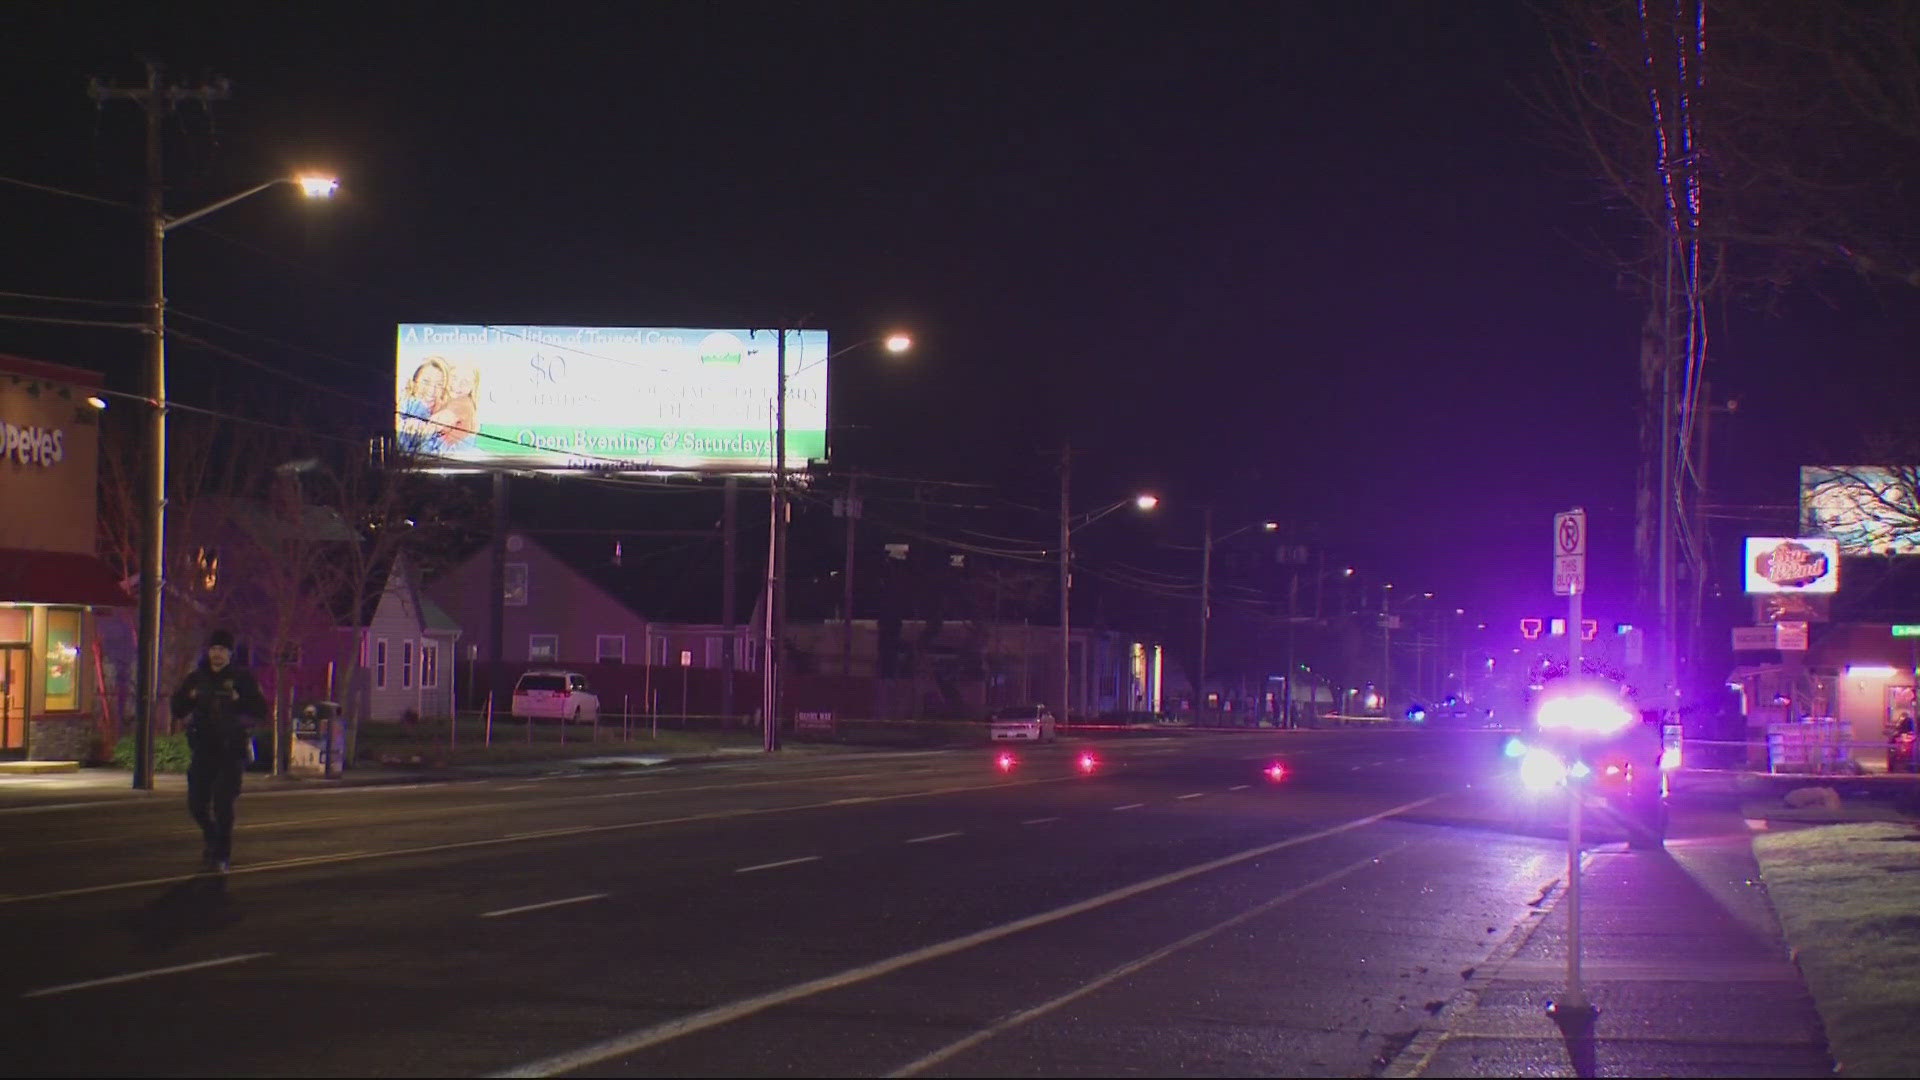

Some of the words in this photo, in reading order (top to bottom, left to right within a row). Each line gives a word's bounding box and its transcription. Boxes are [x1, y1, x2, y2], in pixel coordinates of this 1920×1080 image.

[406, 328, 418, 343] A
[424, 327, 488, 344] Portland
[567, 329, 583, 345] of
[647, 331, 683, 346] Care
[530, 352, 566, 388] $0
[517, 429, 567, 453] Open
[575, 430, 656, 454] Evenings
[660, 432, 680, 450] &
[1561, 558, 1577, 572] THIS
